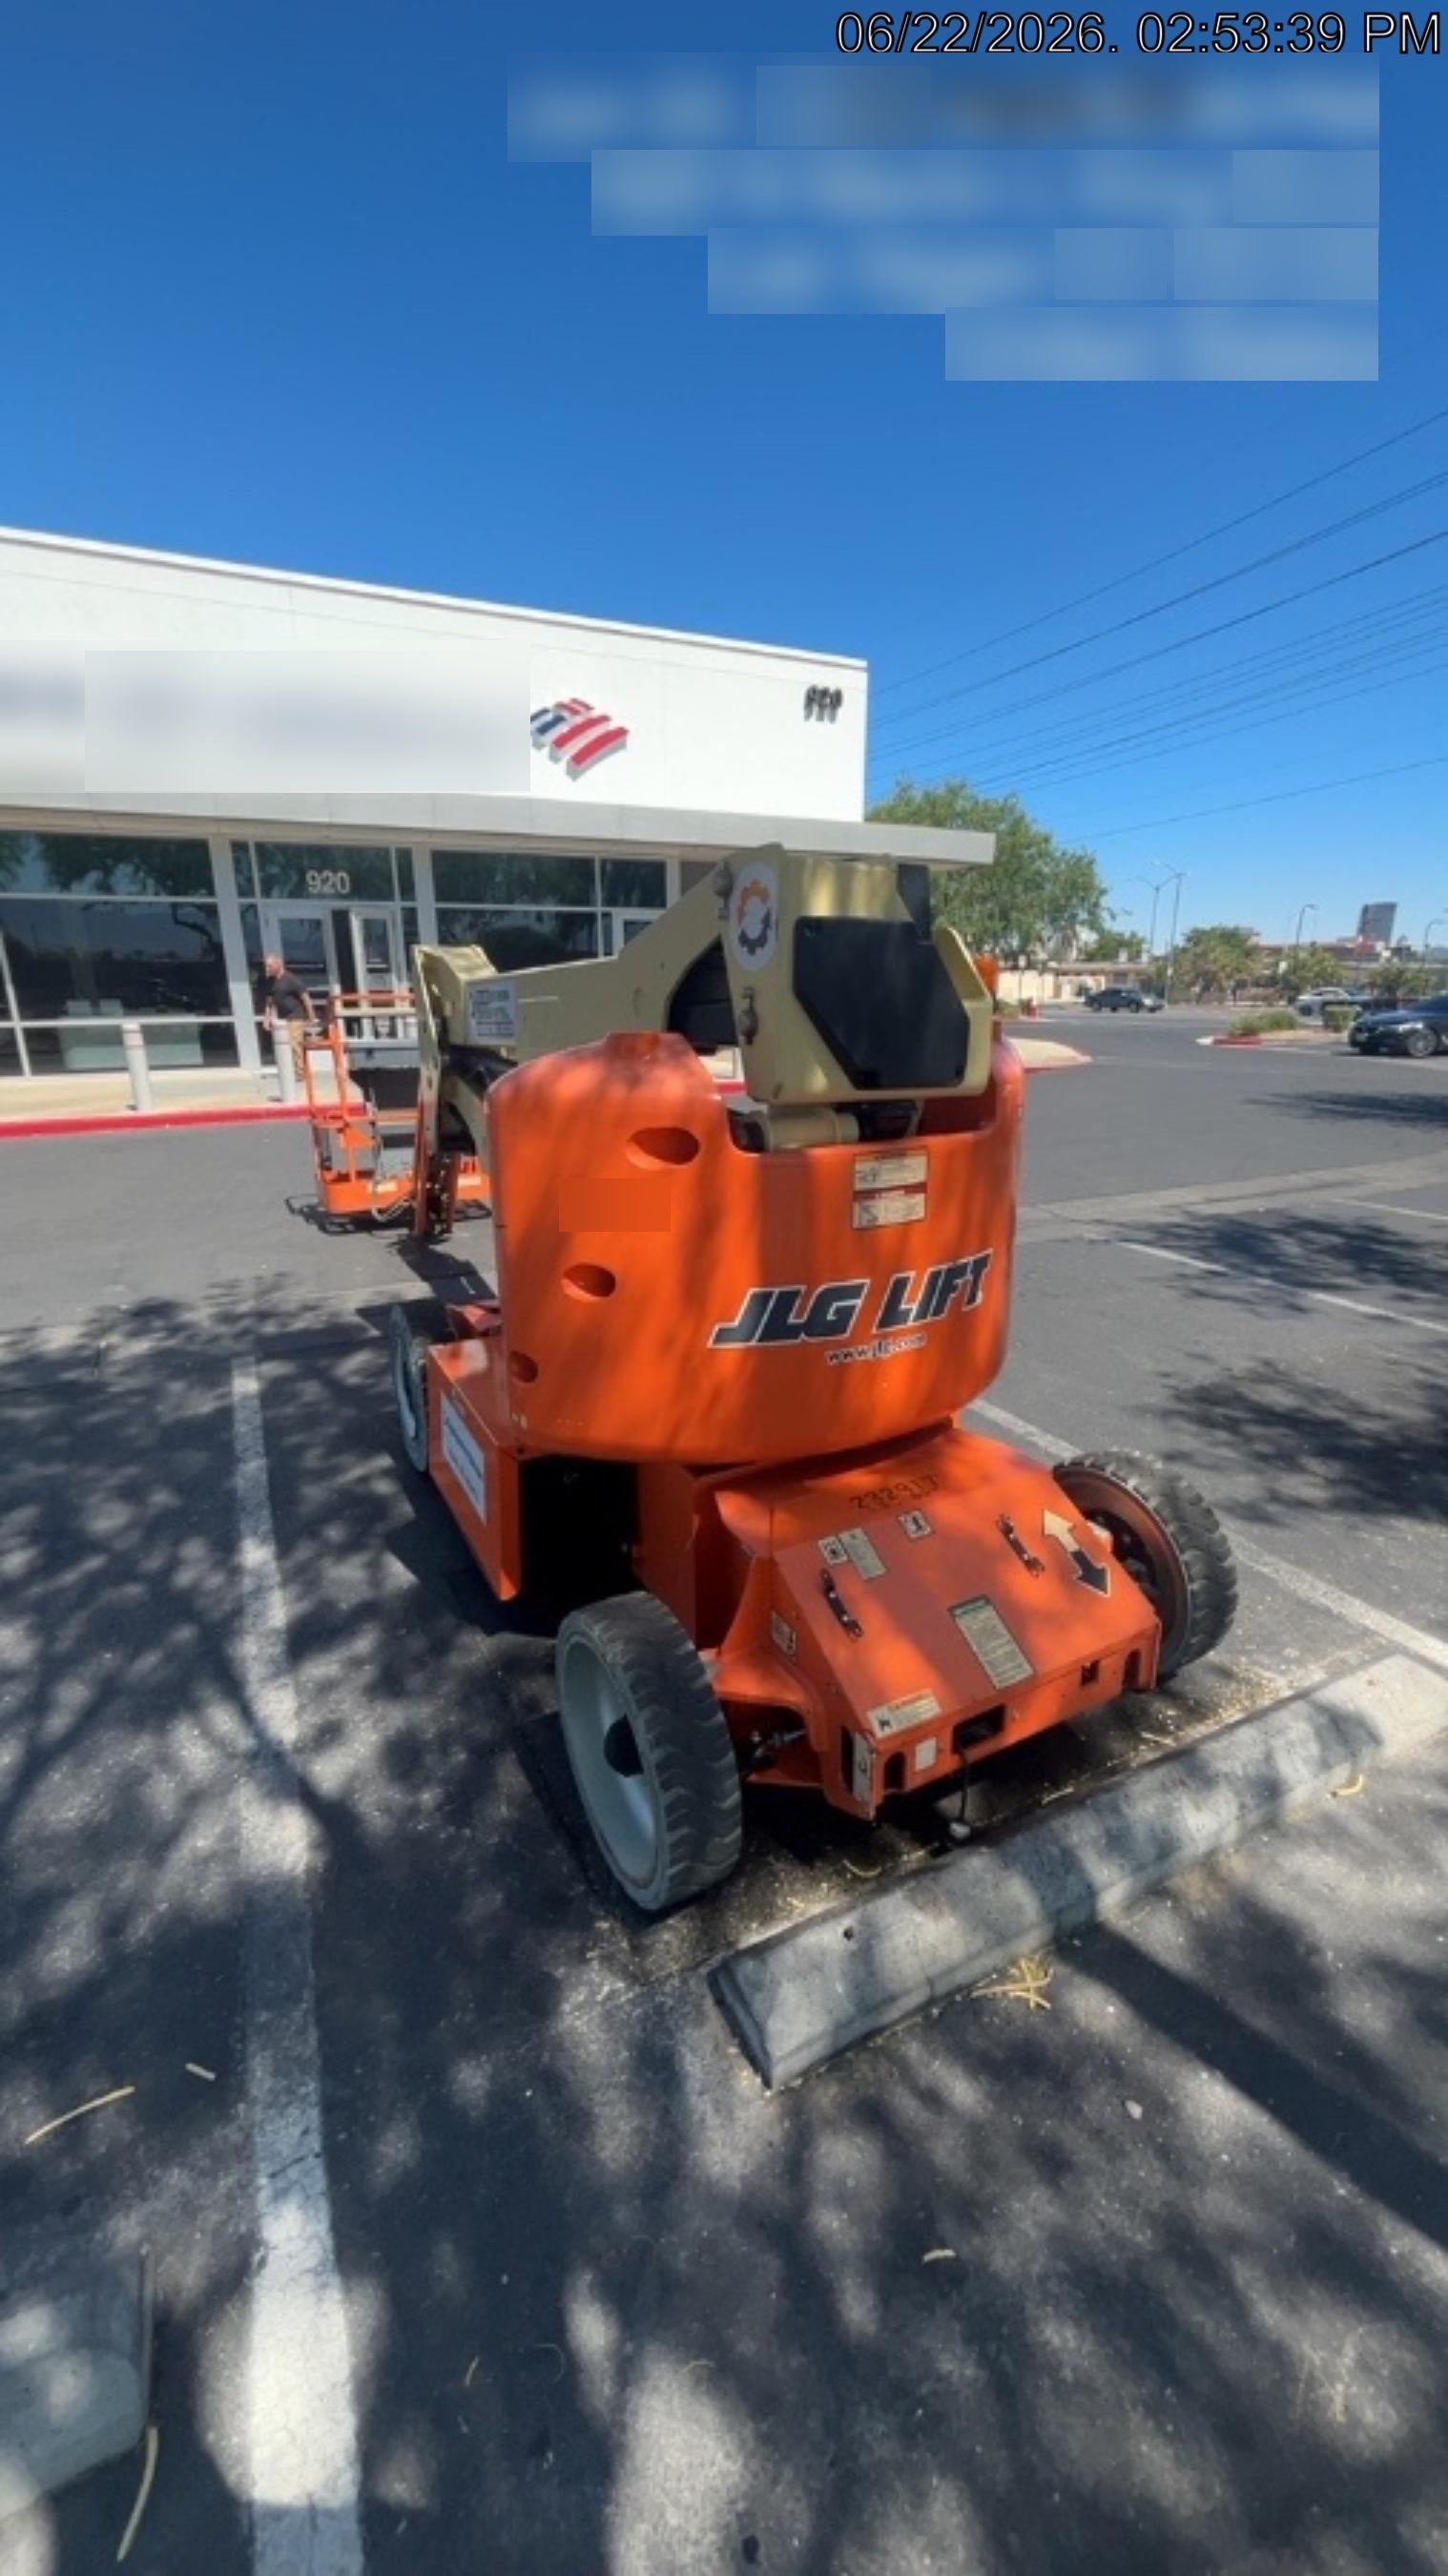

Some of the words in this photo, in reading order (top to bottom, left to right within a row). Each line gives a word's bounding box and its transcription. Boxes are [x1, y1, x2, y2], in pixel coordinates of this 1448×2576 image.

[306, 869, 350, 893] 920
[707, 1278, 870, 1348] JLG
[872, 1248, 994, 1333] LIFT
